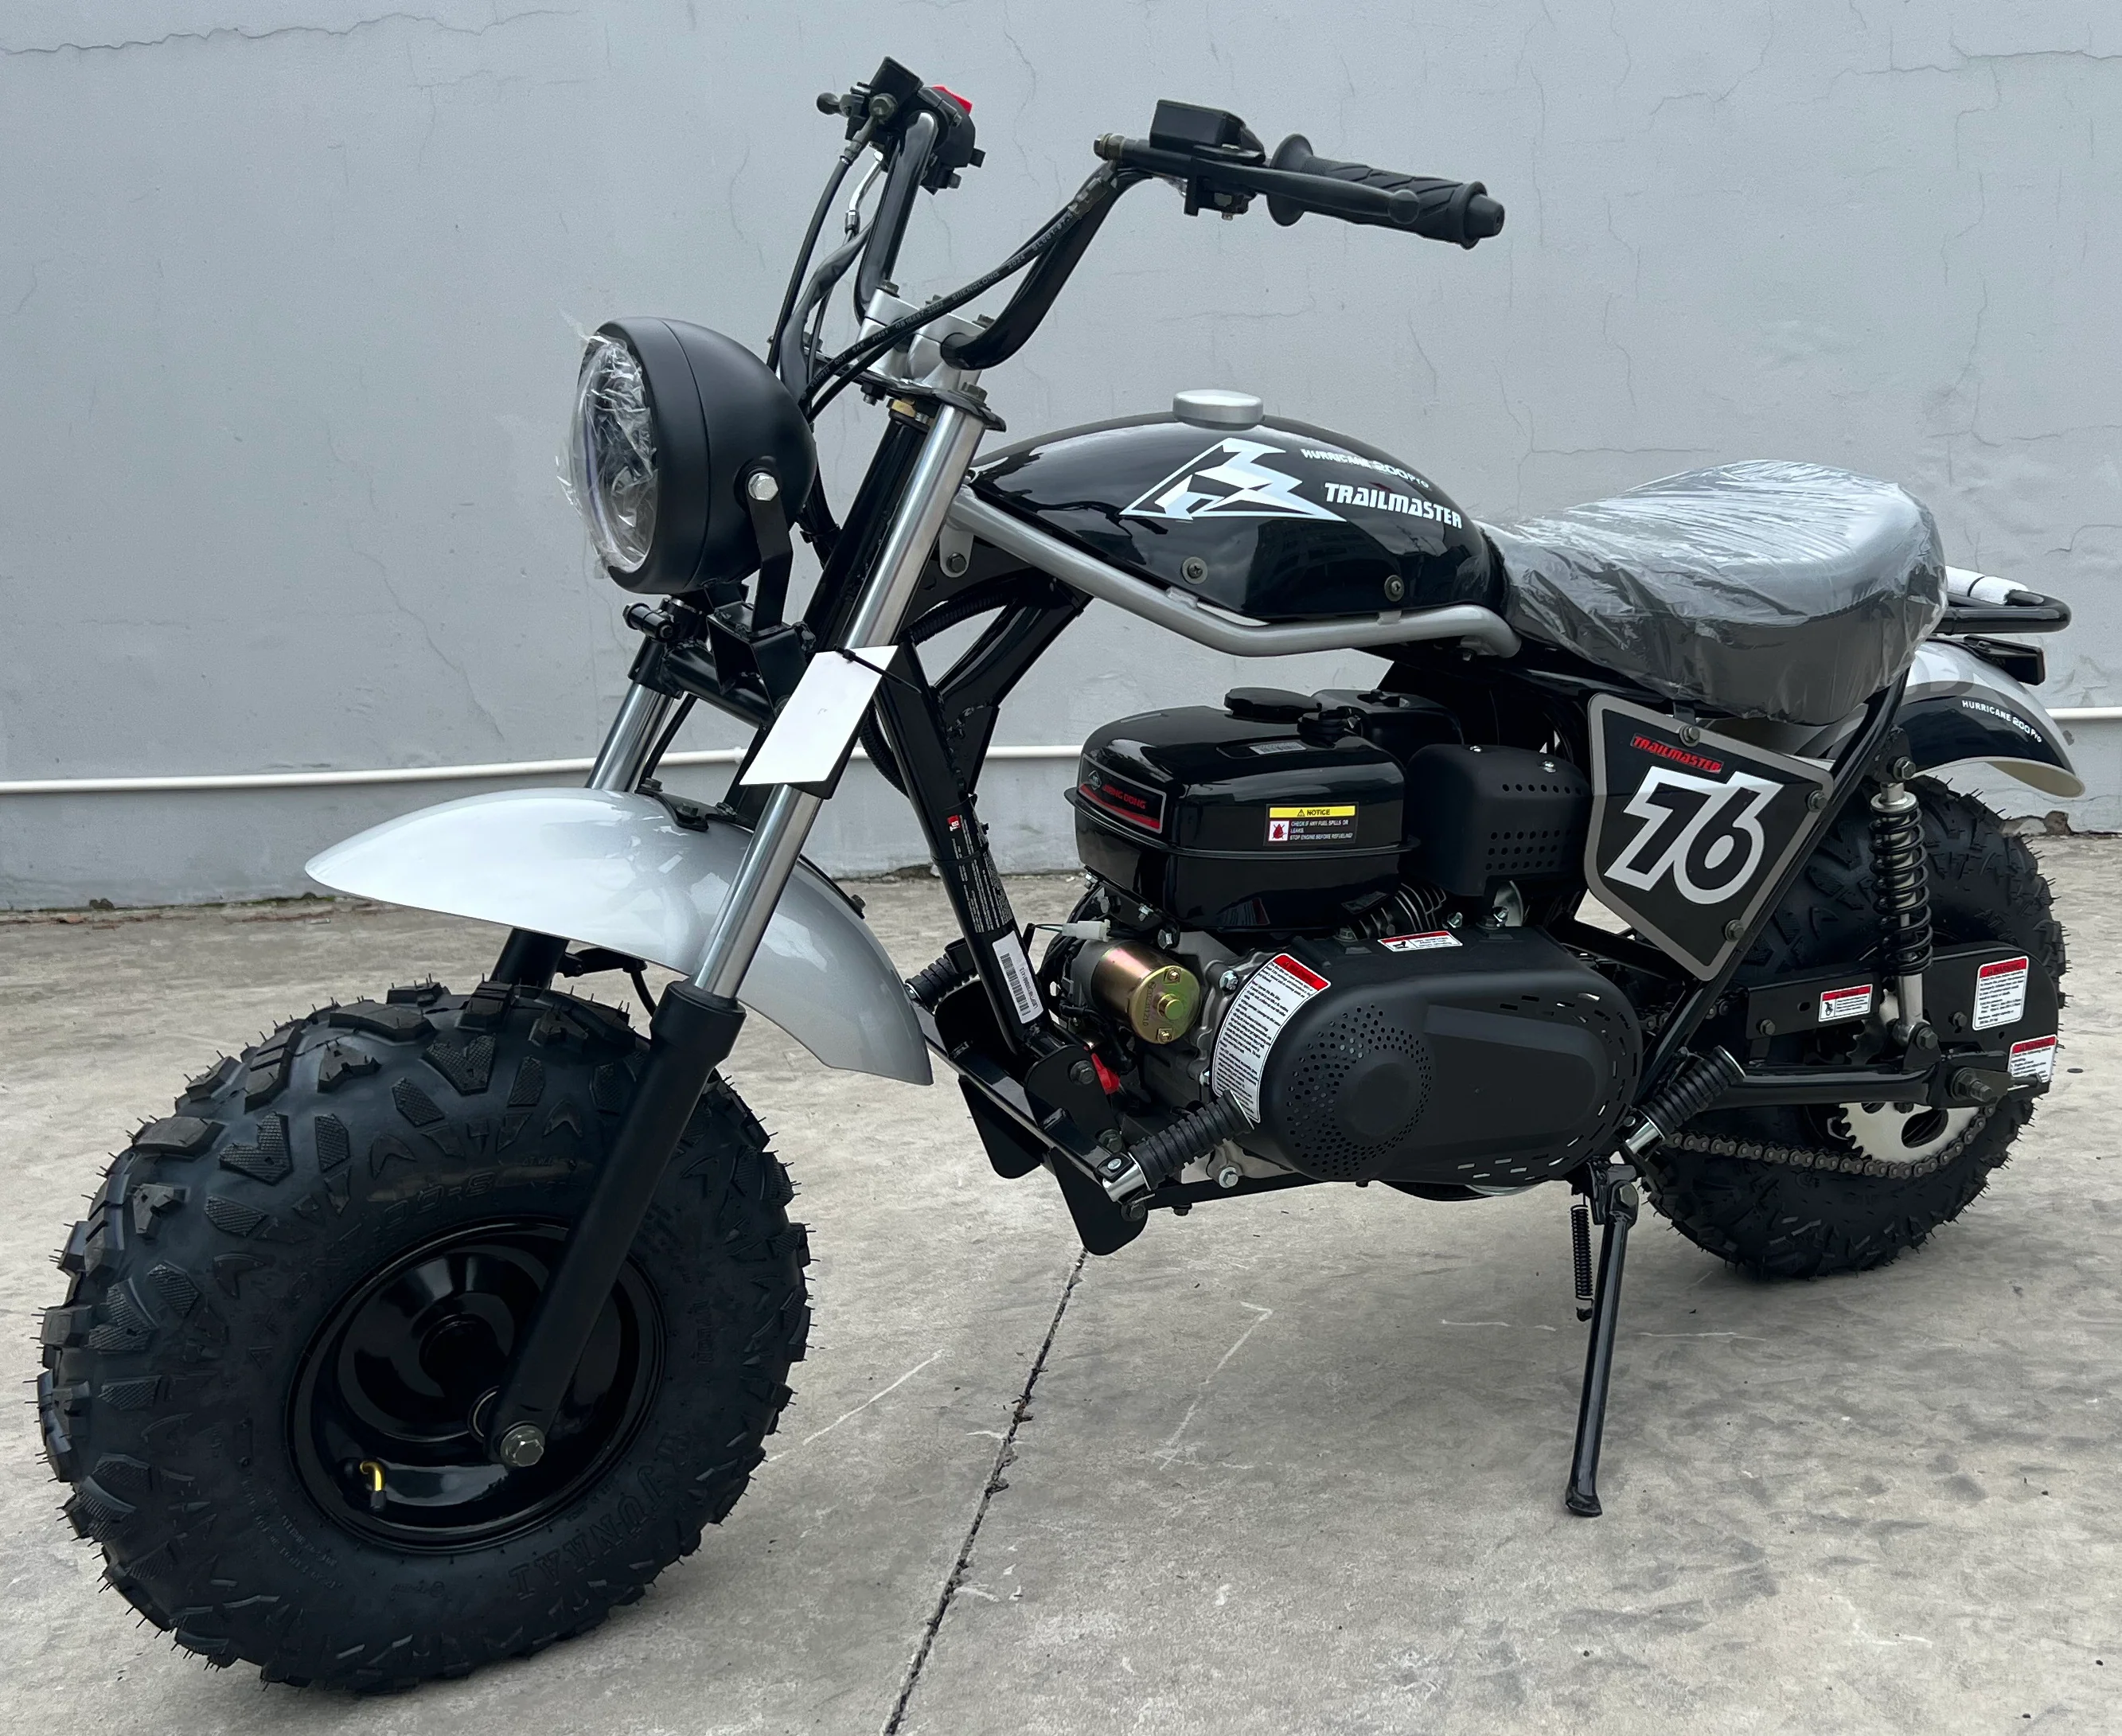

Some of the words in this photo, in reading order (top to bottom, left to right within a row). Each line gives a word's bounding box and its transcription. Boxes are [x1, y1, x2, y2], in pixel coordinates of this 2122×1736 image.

[951, 271, 1001, 301] SHENGLONG
[1006, 254, 1025, 270] 2024
[1324, 482, 1463, 530] TRAILMASTER
[1961, 700, 2011, 722] HURRICANE
[1632, 735, 1722, 771] TRAILMASTER
[1124, 793, 1148, 810] DONG
[1604, 766, 1785, 905] 76
